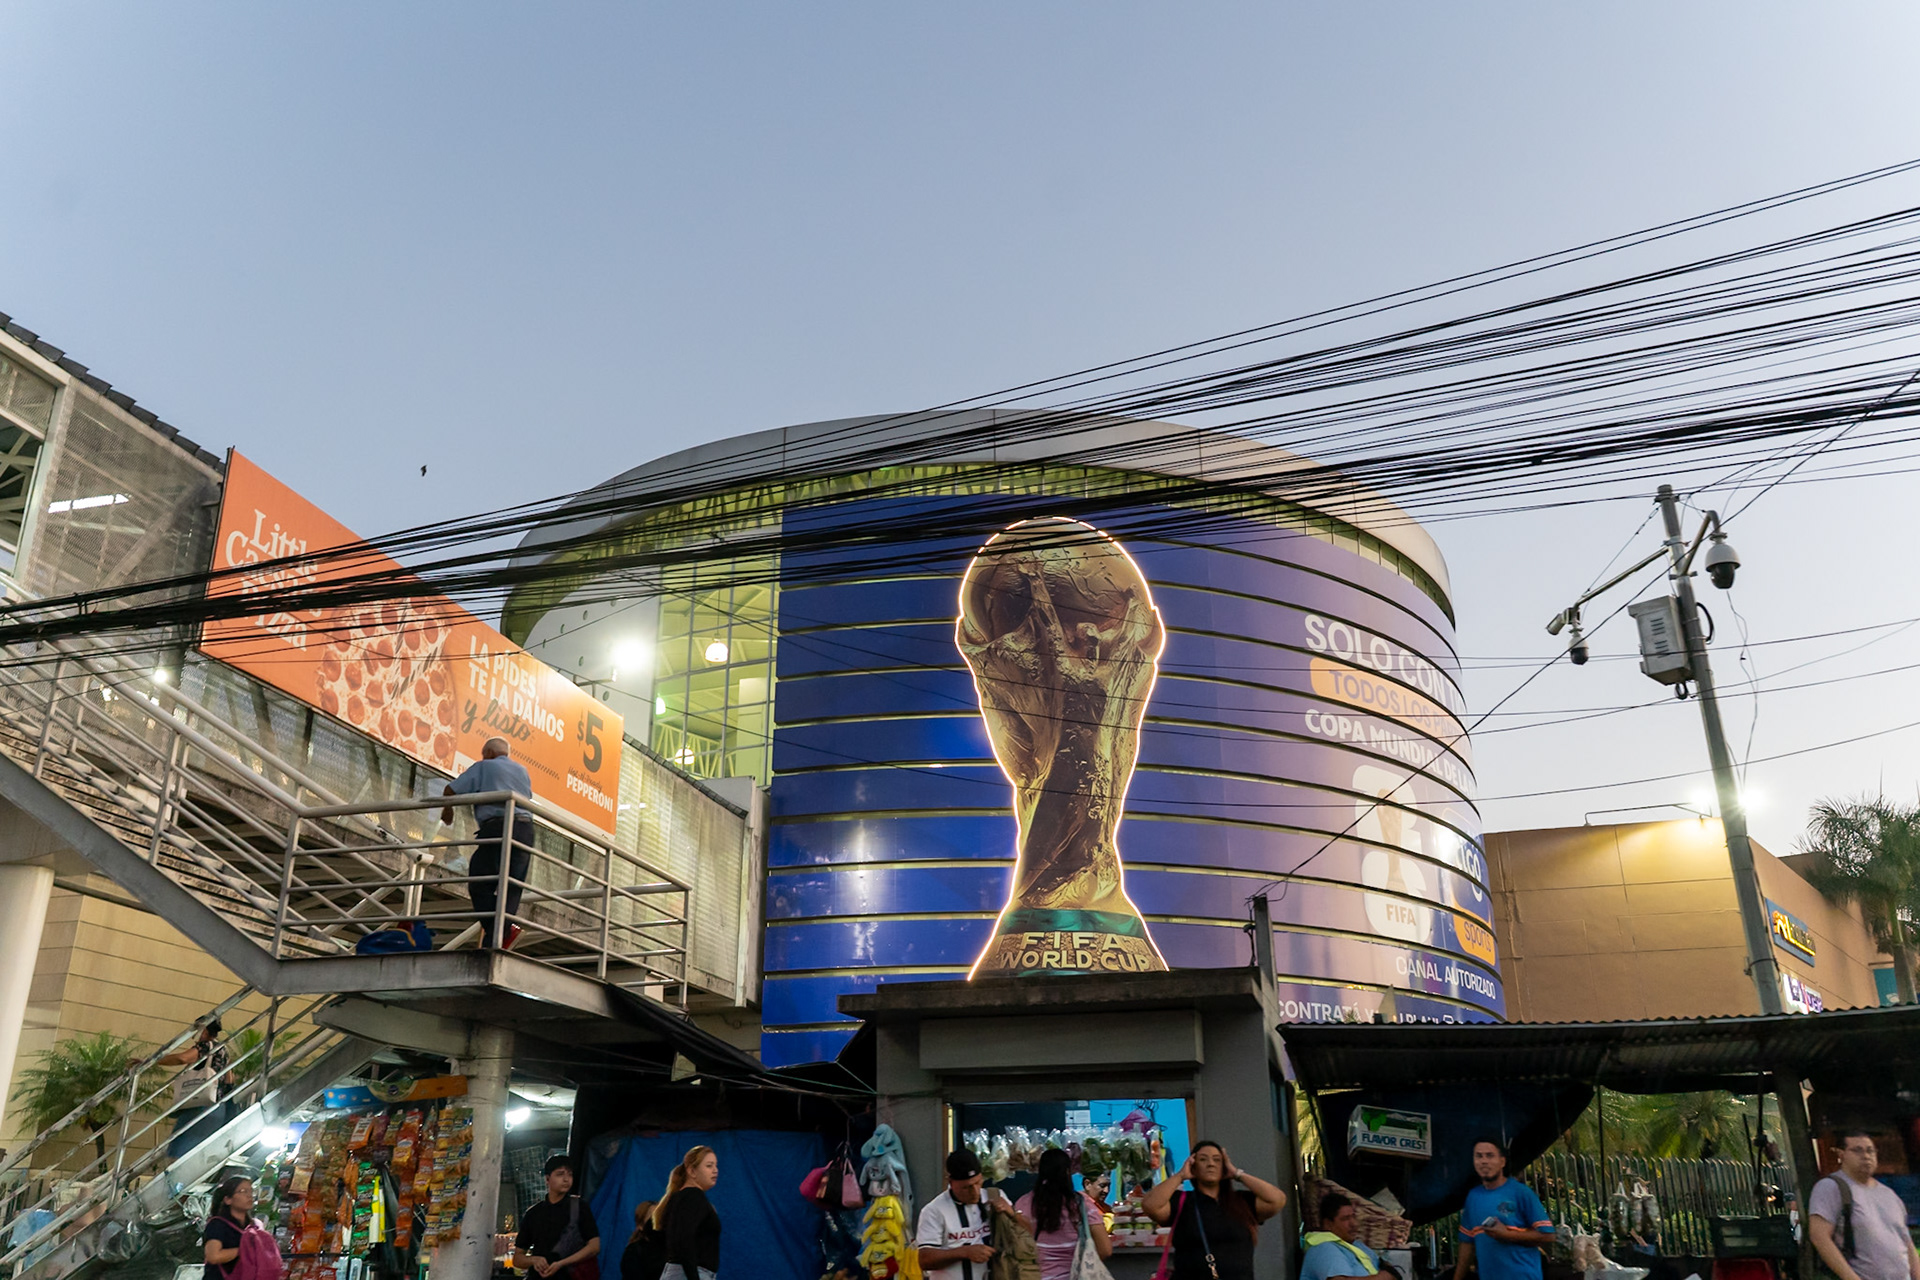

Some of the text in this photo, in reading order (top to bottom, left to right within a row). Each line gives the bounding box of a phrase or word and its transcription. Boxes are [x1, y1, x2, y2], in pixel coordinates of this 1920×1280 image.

[470, 635, 490, 670] LA
[1305, 614, 1393, 675] SOLO
[1399, 649, 1447, 709] CON
[468, 661, 565, 742] TE LA DAMOS
[1329, 670, 1400, 714] TODOS
[461, 698, 531, 742] y listo
[577, 708, 603, 773] $5
[1305, 709, 1368, 748] COPA
[1370, 725, 1443, 776] MUNDIAL
[566, 773, 614, 813] PEPPERONI
[1386, 904, 1416, 926] FIFA
[1464, 920, 1492, 952] sports
[1000, 950, 1151, 973] WORLD CUP
[1020, 931, 1128, 953] FIFA
[1395, 956, 1496, 1000] CANAL AUTORIZADO
[1362, 1133, 1397, 1147] FLAVOR
[1400, 1137, 1427, 1150] CREST
